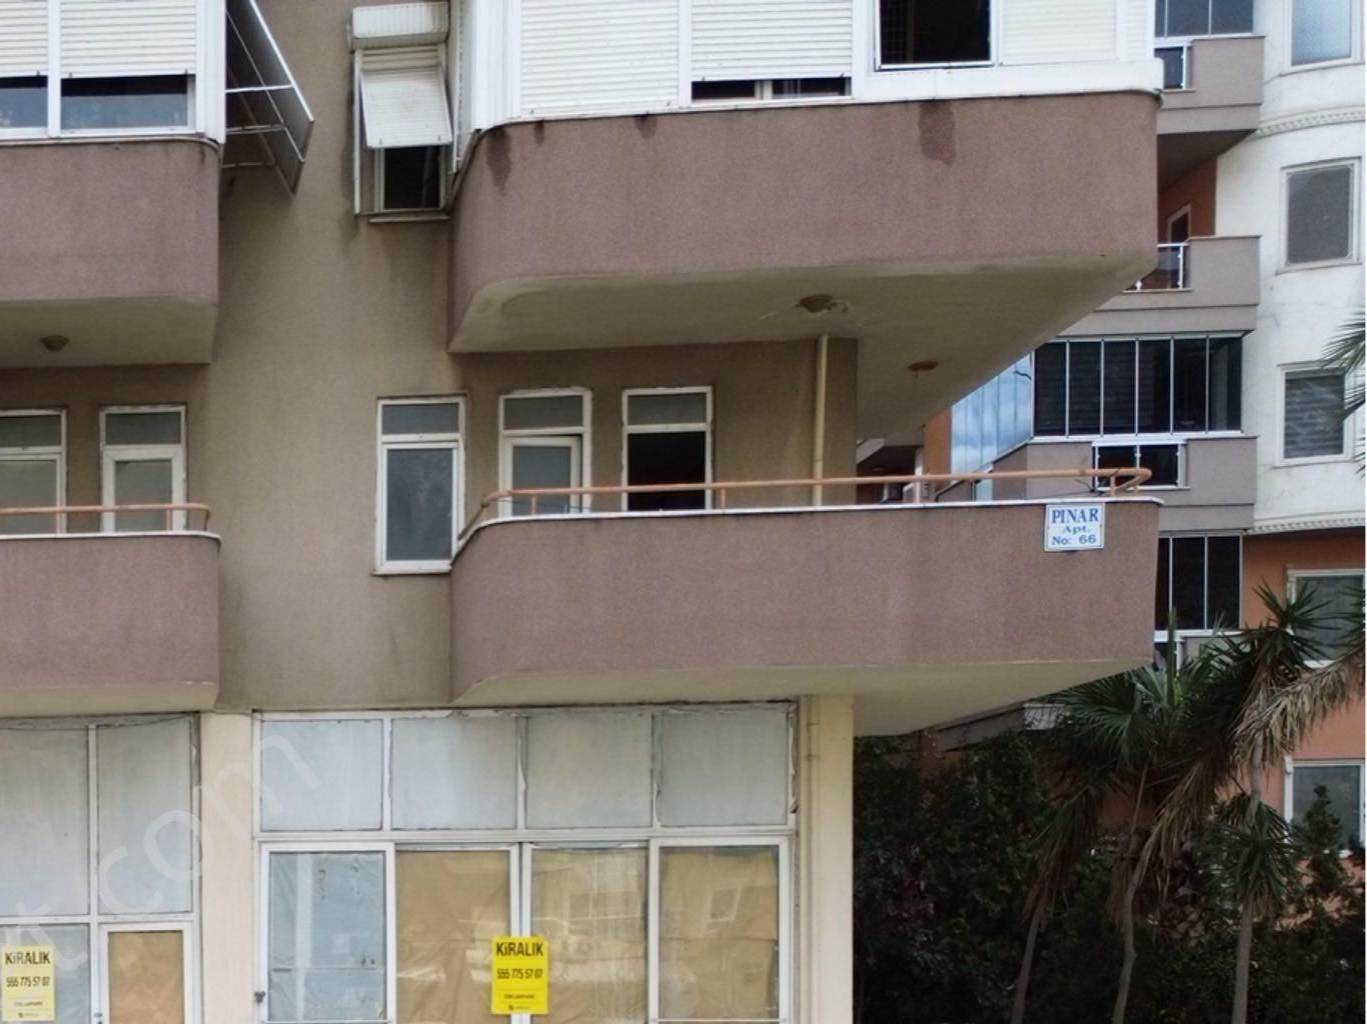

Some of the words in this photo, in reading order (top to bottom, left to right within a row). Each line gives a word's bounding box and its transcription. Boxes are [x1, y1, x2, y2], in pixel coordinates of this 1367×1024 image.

[1051, 508, 1099, 524] PINAR
[1062, 525, 1091, 535] Apt.
[1078, 534, 1097, 544] 66
